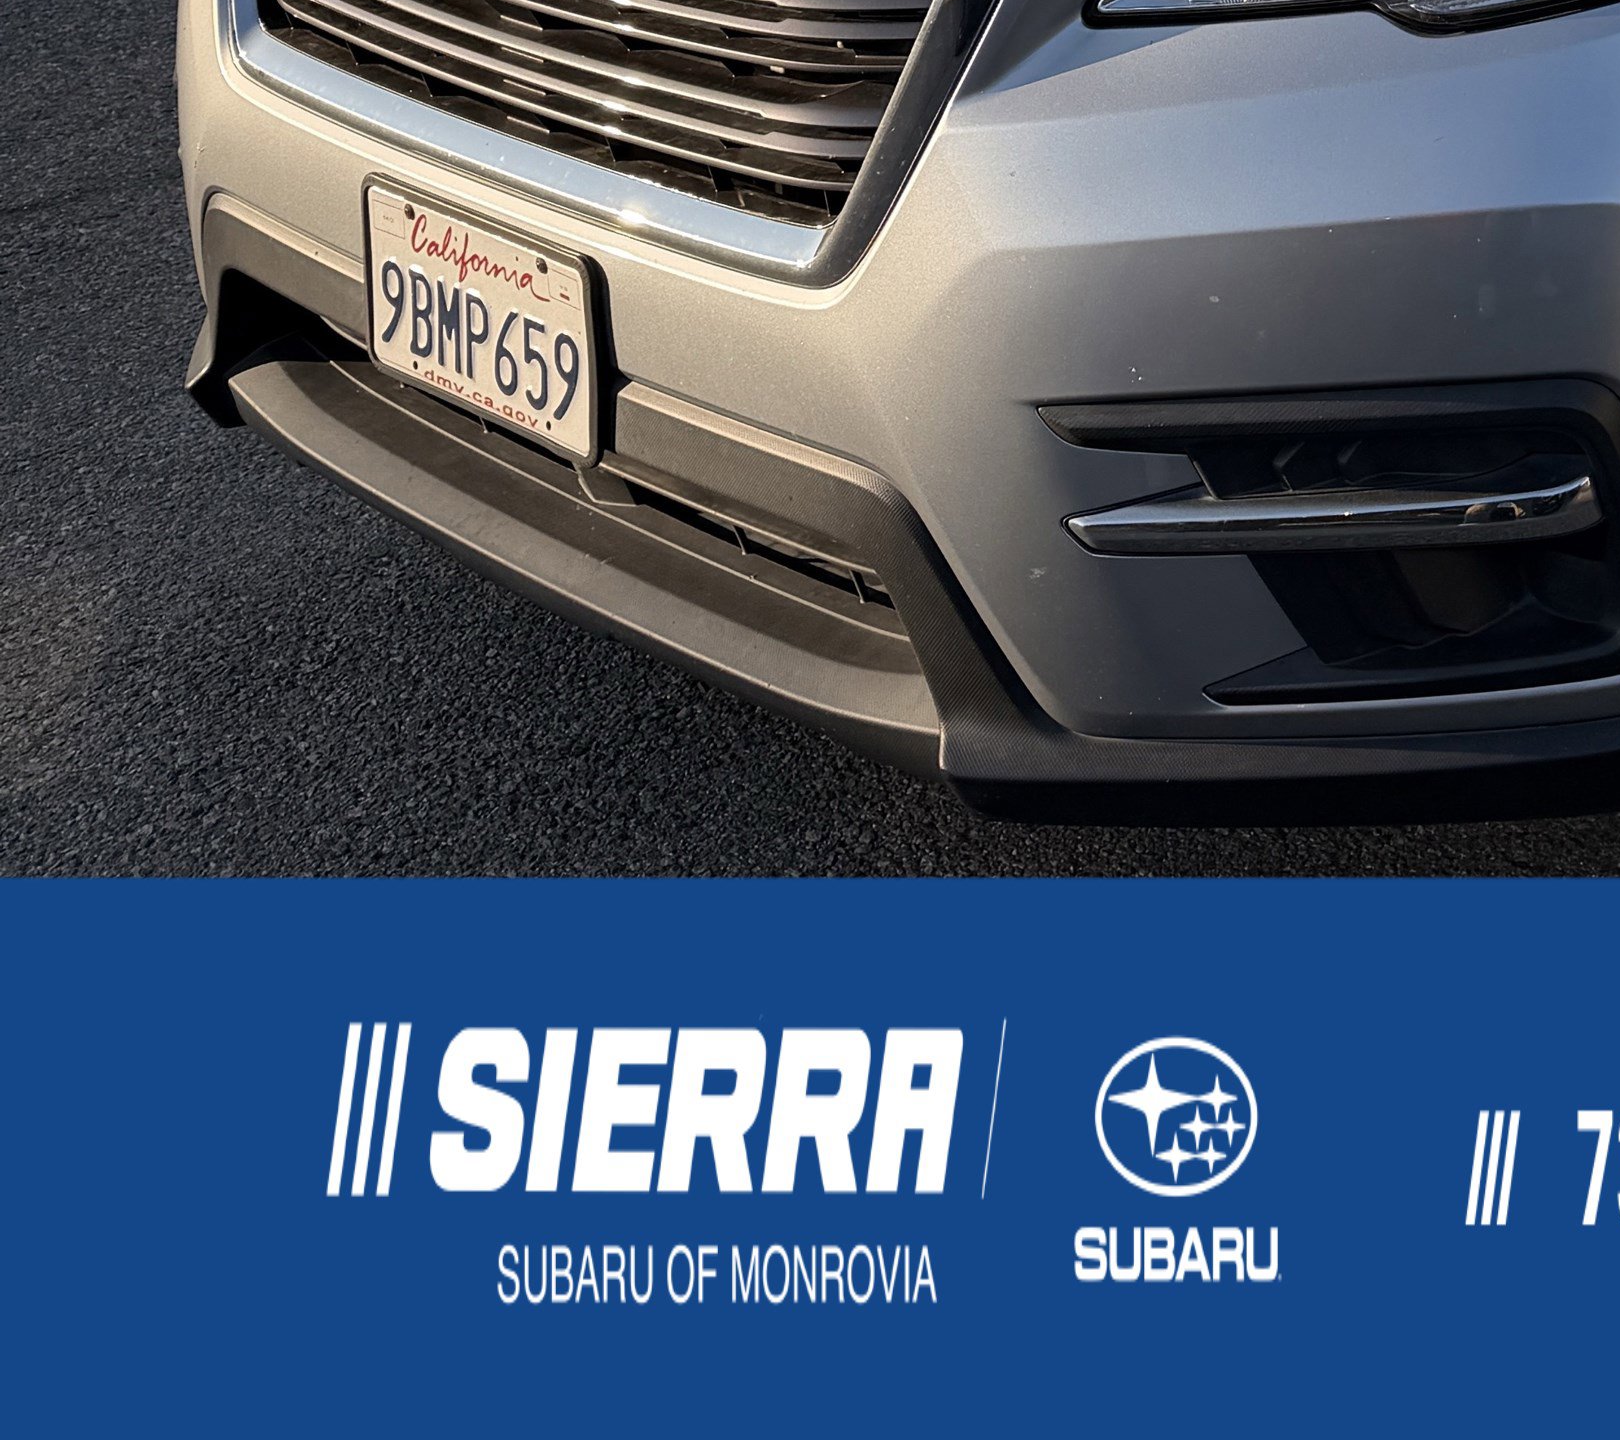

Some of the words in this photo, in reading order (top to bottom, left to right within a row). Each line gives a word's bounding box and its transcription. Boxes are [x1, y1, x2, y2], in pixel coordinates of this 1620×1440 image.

[410, 213, 551, 303] California
[381, 258, 579, 421] 9BMP659
[423, 368, 540, 429] dmv.ca.gov
